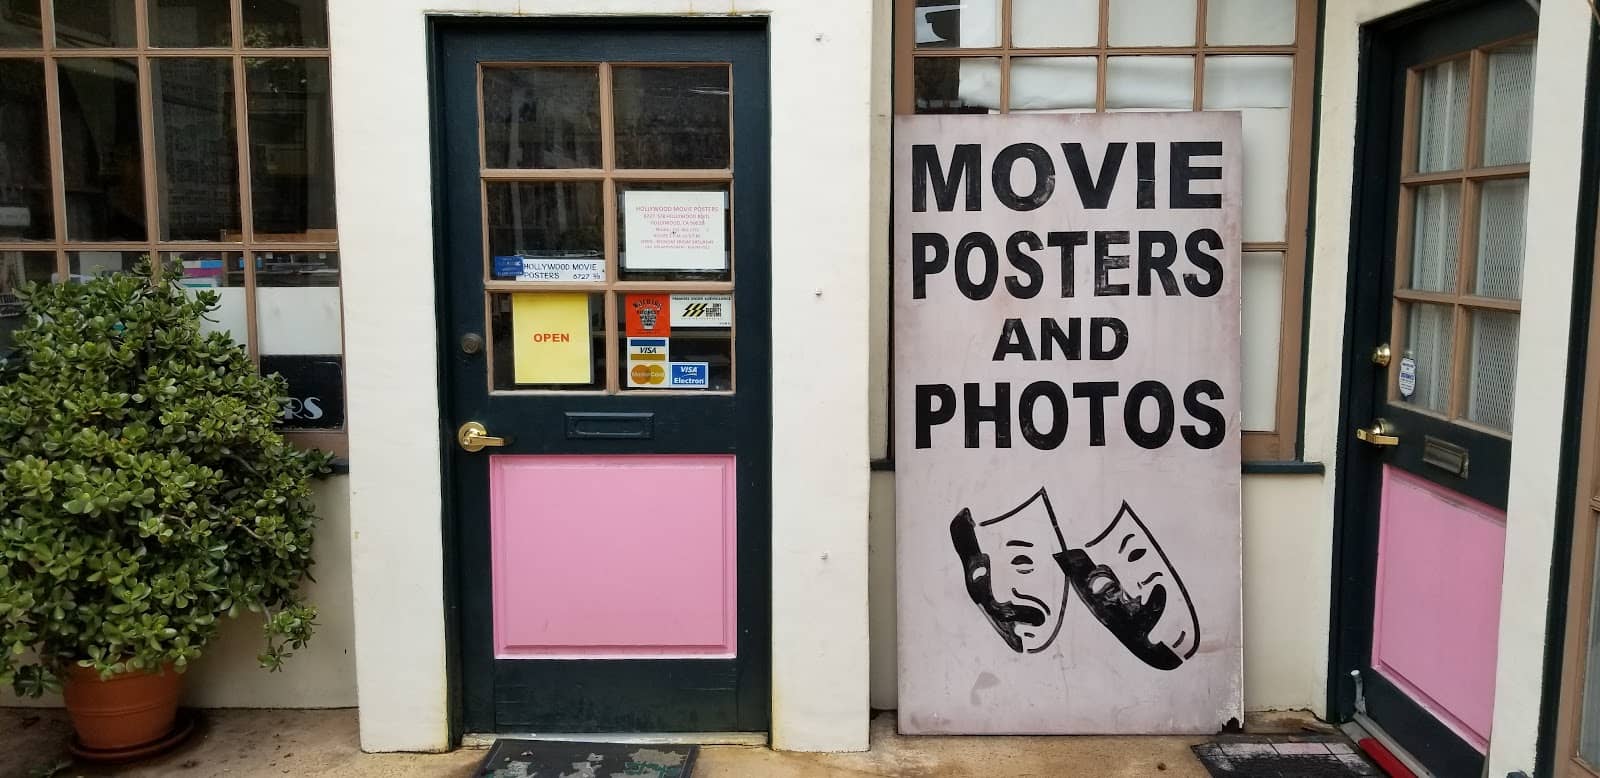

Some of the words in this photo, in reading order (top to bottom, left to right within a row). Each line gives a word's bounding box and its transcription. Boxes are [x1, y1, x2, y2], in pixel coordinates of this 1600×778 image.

[912, 141, 1223, 212] MOVIE
[524, 263, 570, 271] HOLLYWOOD
[572, 263, 598, 271] MOVIE
[912, 228, 1224, 300] POSTERS
[524, 272, 560, 280] POSTERS
[533, 333, 570, 343] OPEN
[992, 317, 1129, 361] AND
[640, 346, 657, 354] VISA
[673, 377, 705, 385] Electron
[915, 379, 1226, 450] PHOTOS
